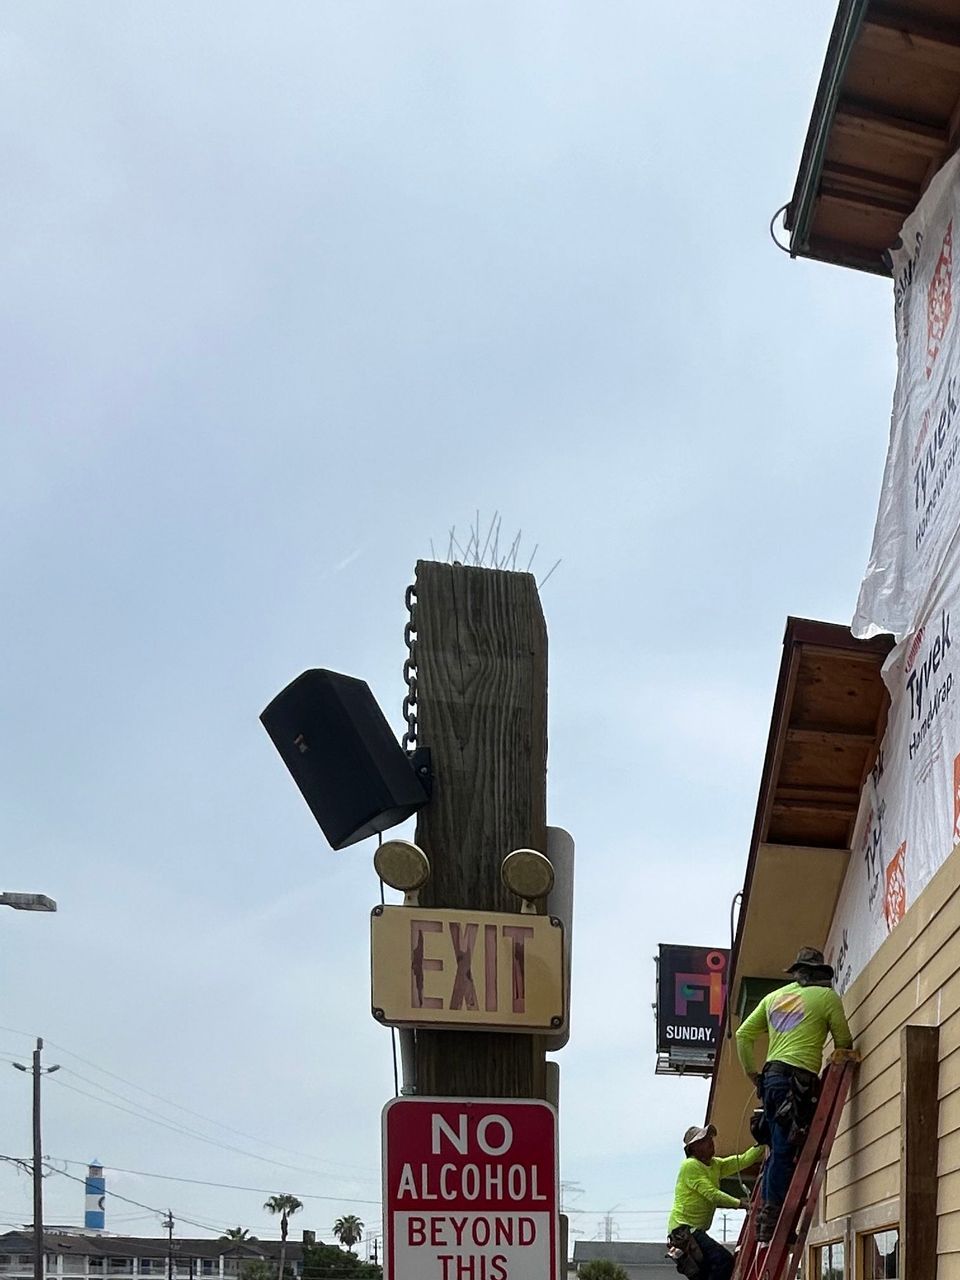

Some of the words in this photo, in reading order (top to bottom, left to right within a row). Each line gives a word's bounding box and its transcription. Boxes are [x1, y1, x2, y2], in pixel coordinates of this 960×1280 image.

[914, 376, 957, 511] Tyvek
[906, 609, 951, 721] Tyvek
[909, 673, 954, 760] HomeWrap
[410, 919, 535, 1014] EXIT
[666, 1024, 716, 1043] SUNDAY,
[431, 1113, 514, 1156] NO
[396, 1163, 548, 1201] ALCOHOL
[407, 1216, 537, 1247] BEYOND
